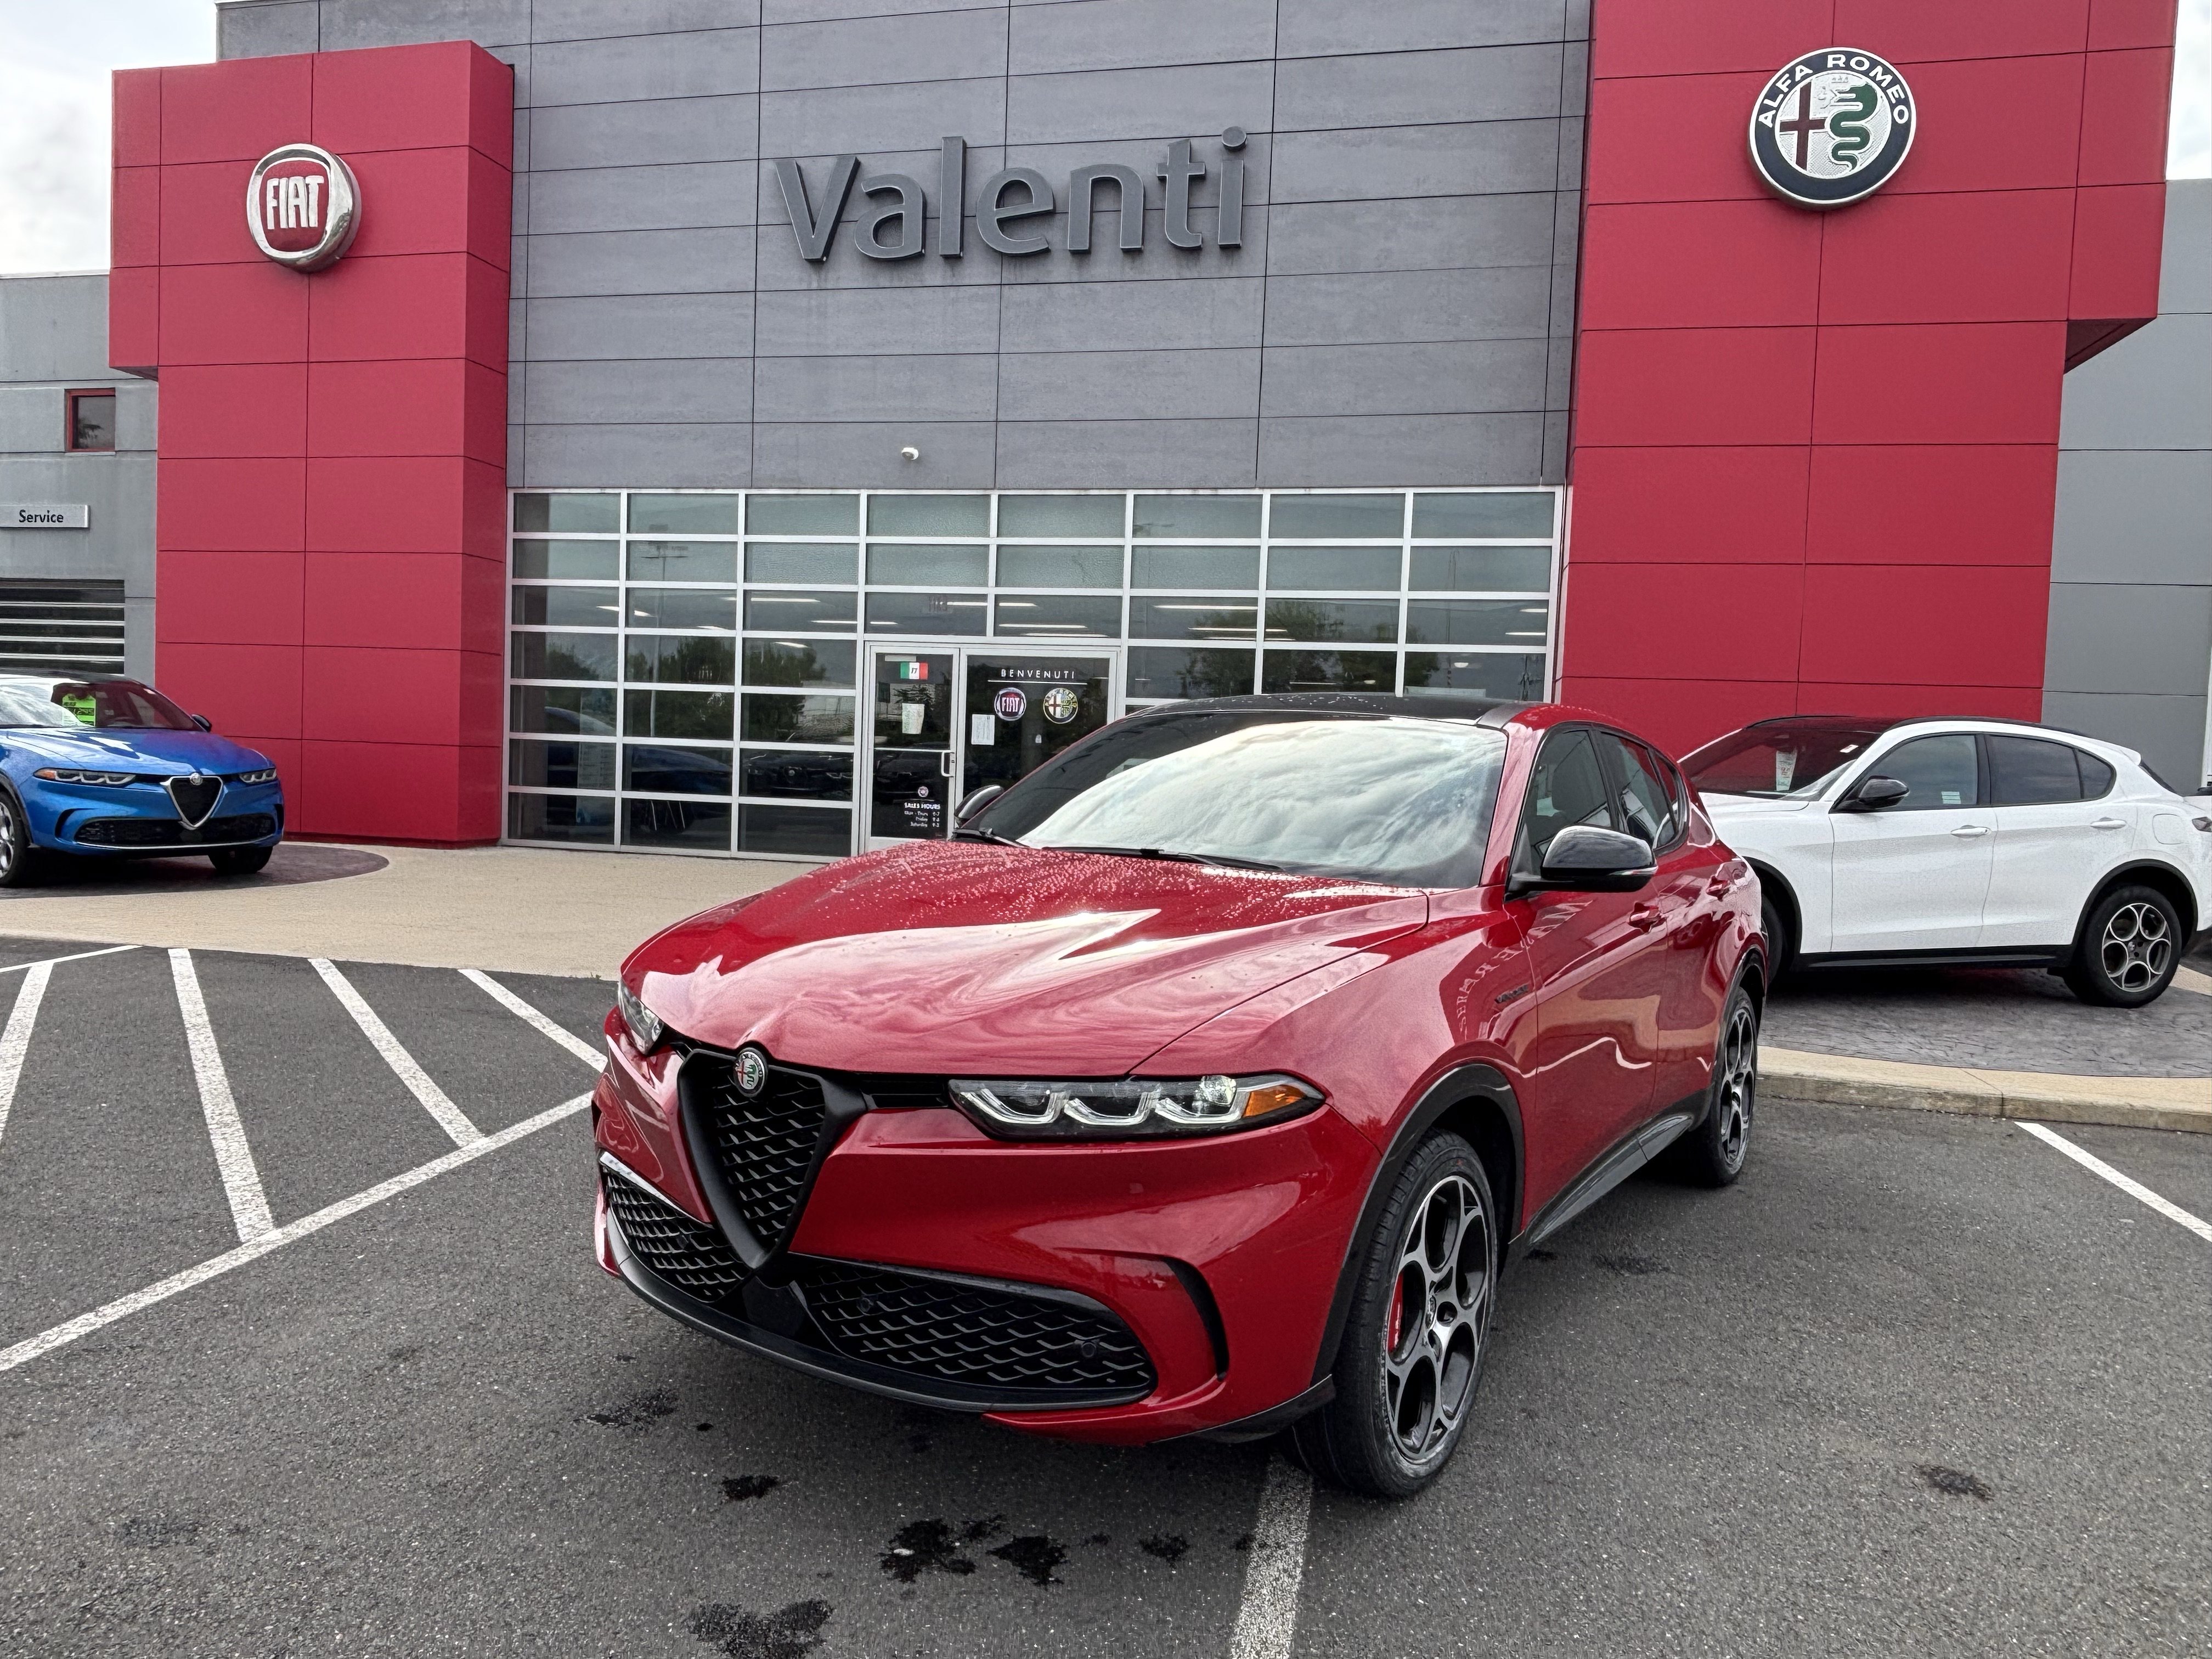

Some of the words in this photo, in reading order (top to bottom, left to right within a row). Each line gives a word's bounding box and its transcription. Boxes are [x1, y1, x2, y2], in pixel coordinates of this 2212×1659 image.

[1758, 64, 1813, 128] ALFA
[1827, 54, 1909, 124] ROMEO
[267, 175, 324, 230] FIAT
[775, 126, 1248, 262] Valenti
[19, 509, 64, 523] Service
[1001, 669, 1075, 679] BENVENUTI
[1002, 697, 1020, 712] FIAT
